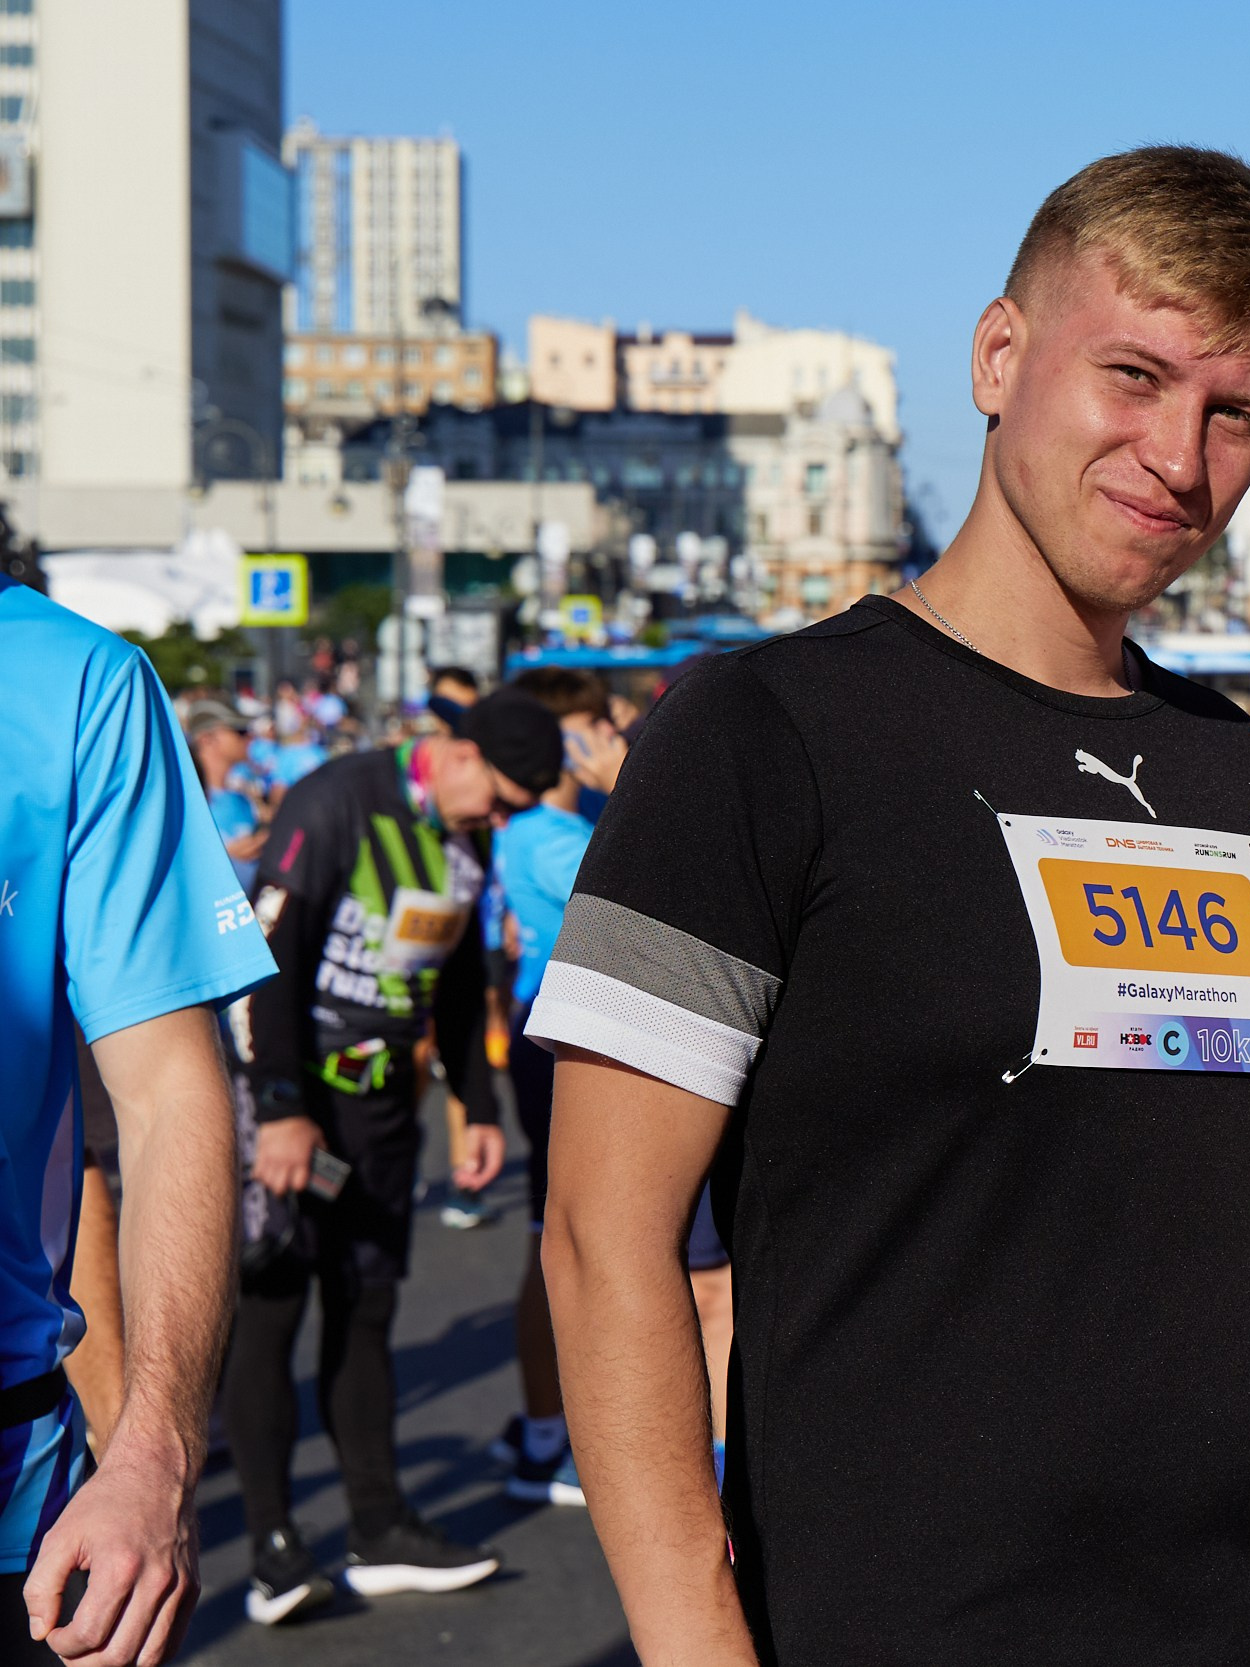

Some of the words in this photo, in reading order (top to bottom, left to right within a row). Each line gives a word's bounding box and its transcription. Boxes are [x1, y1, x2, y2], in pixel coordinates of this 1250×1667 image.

[1105, 837, 1136, 849] DNS
[1195, 848, 1237, 860] RUNDNSRUN
[1082, 883, 1239, 954] 5146
[1117, 982, 1238, 1003] #GalaxyMarathon
[1076, 1034, 1095, 1046] VL.RU
[1163, 1030, 1181, 1056] C
